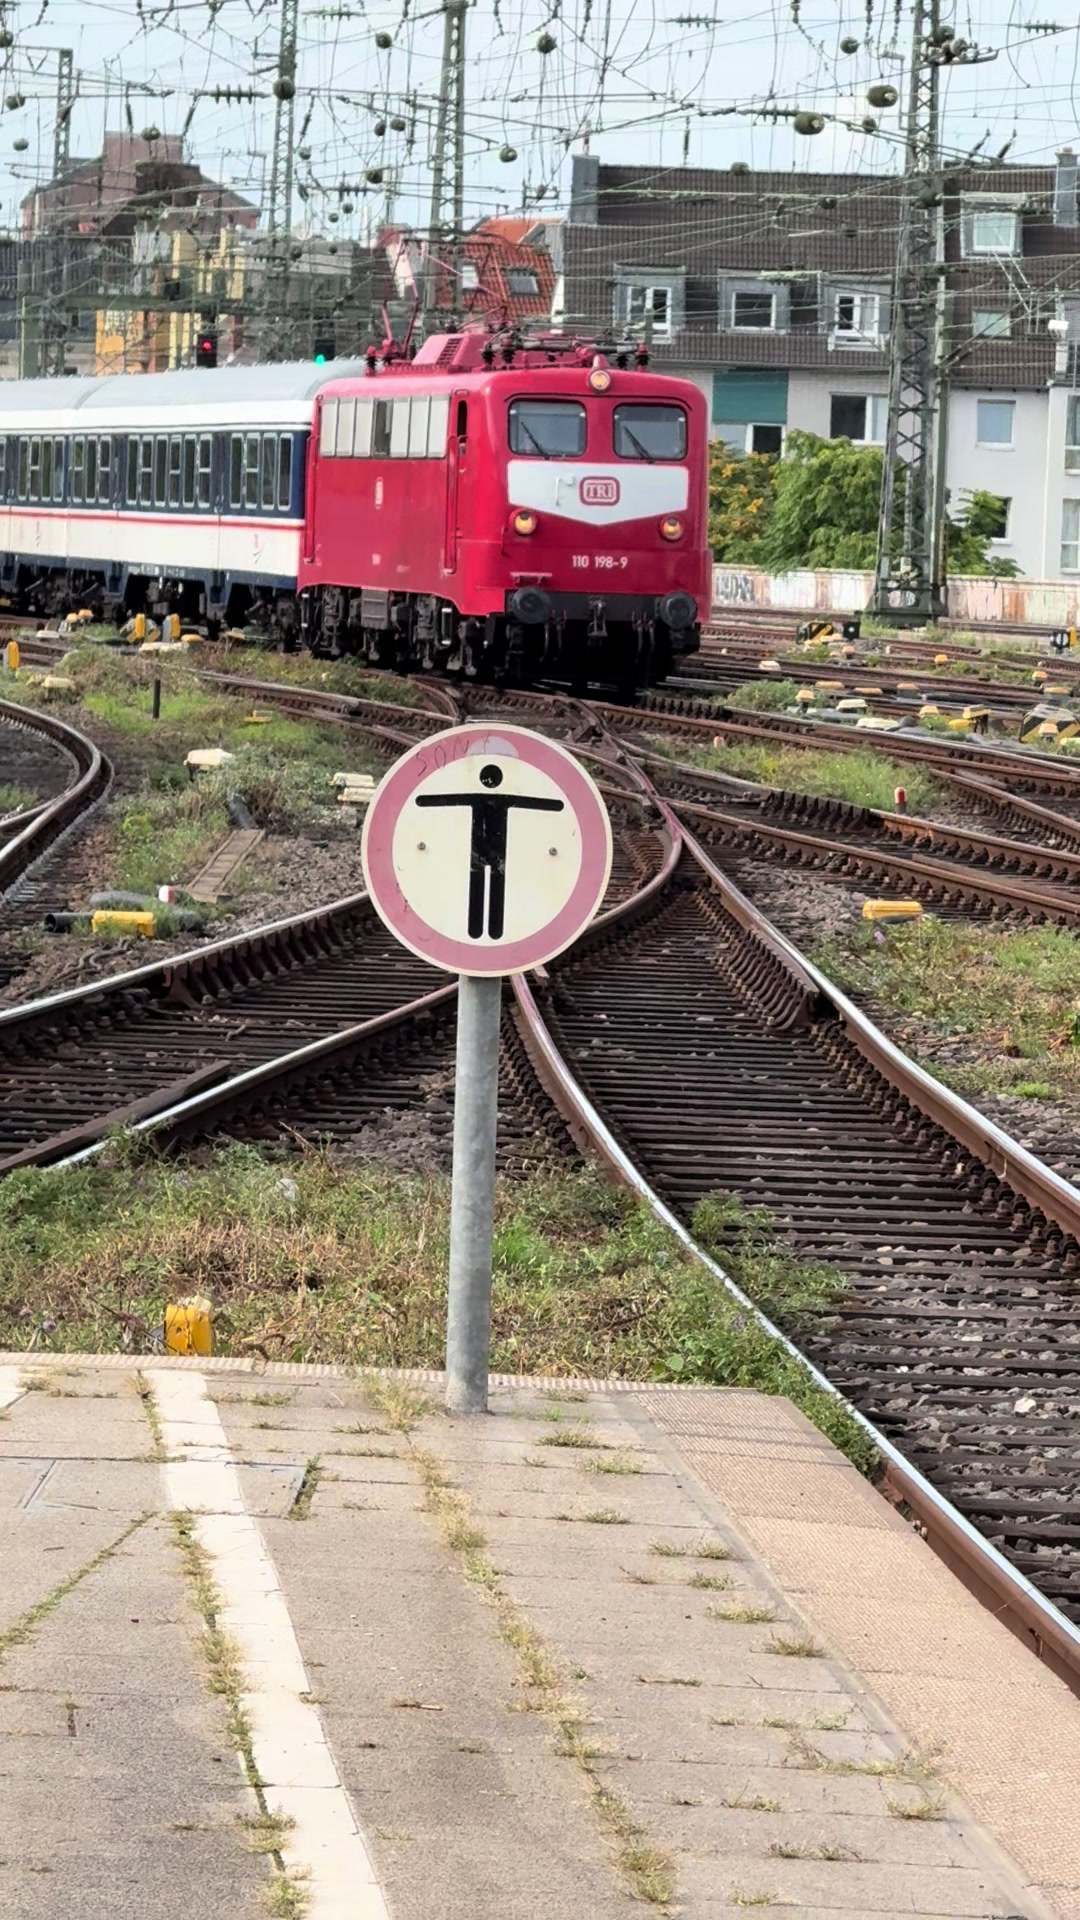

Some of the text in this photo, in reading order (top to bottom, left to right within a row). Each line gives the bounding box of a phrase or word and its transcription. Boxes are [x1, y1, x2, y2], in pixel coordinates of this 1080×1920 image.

[586, 484, 614, 499] TRI
[572, 555, 628, 569] 110 198-9
